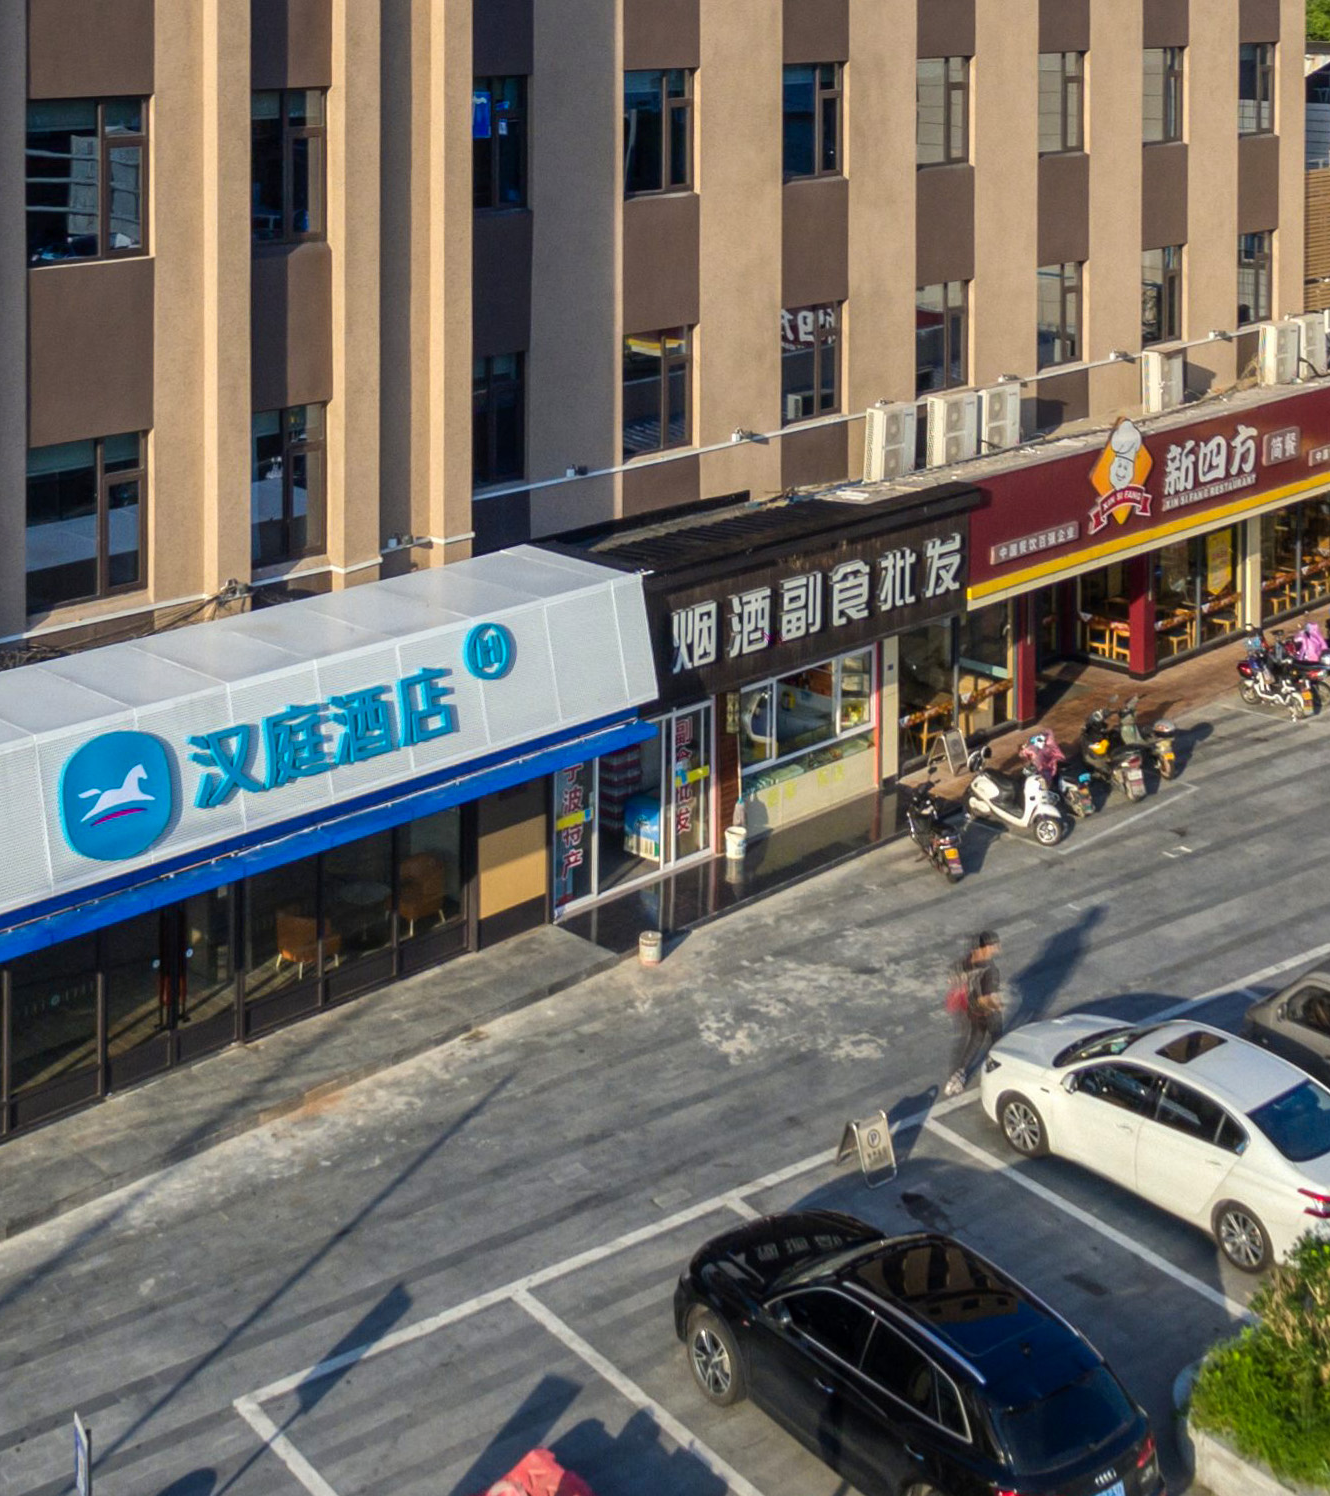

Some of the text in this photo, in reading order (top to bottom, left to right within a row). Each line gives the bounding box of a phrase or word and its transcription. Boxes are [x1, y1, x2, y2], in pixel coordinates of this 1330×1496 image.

[1165, 424, 1258, 496] 新四方
[1271, 432, 1297, 461] 简餐
[1209, 473, 1257, 497] RESTAURANT
[671, 533, 963, 674] 烟酒副食批发
[189, 667, 457, 808] 汉庭酒店
